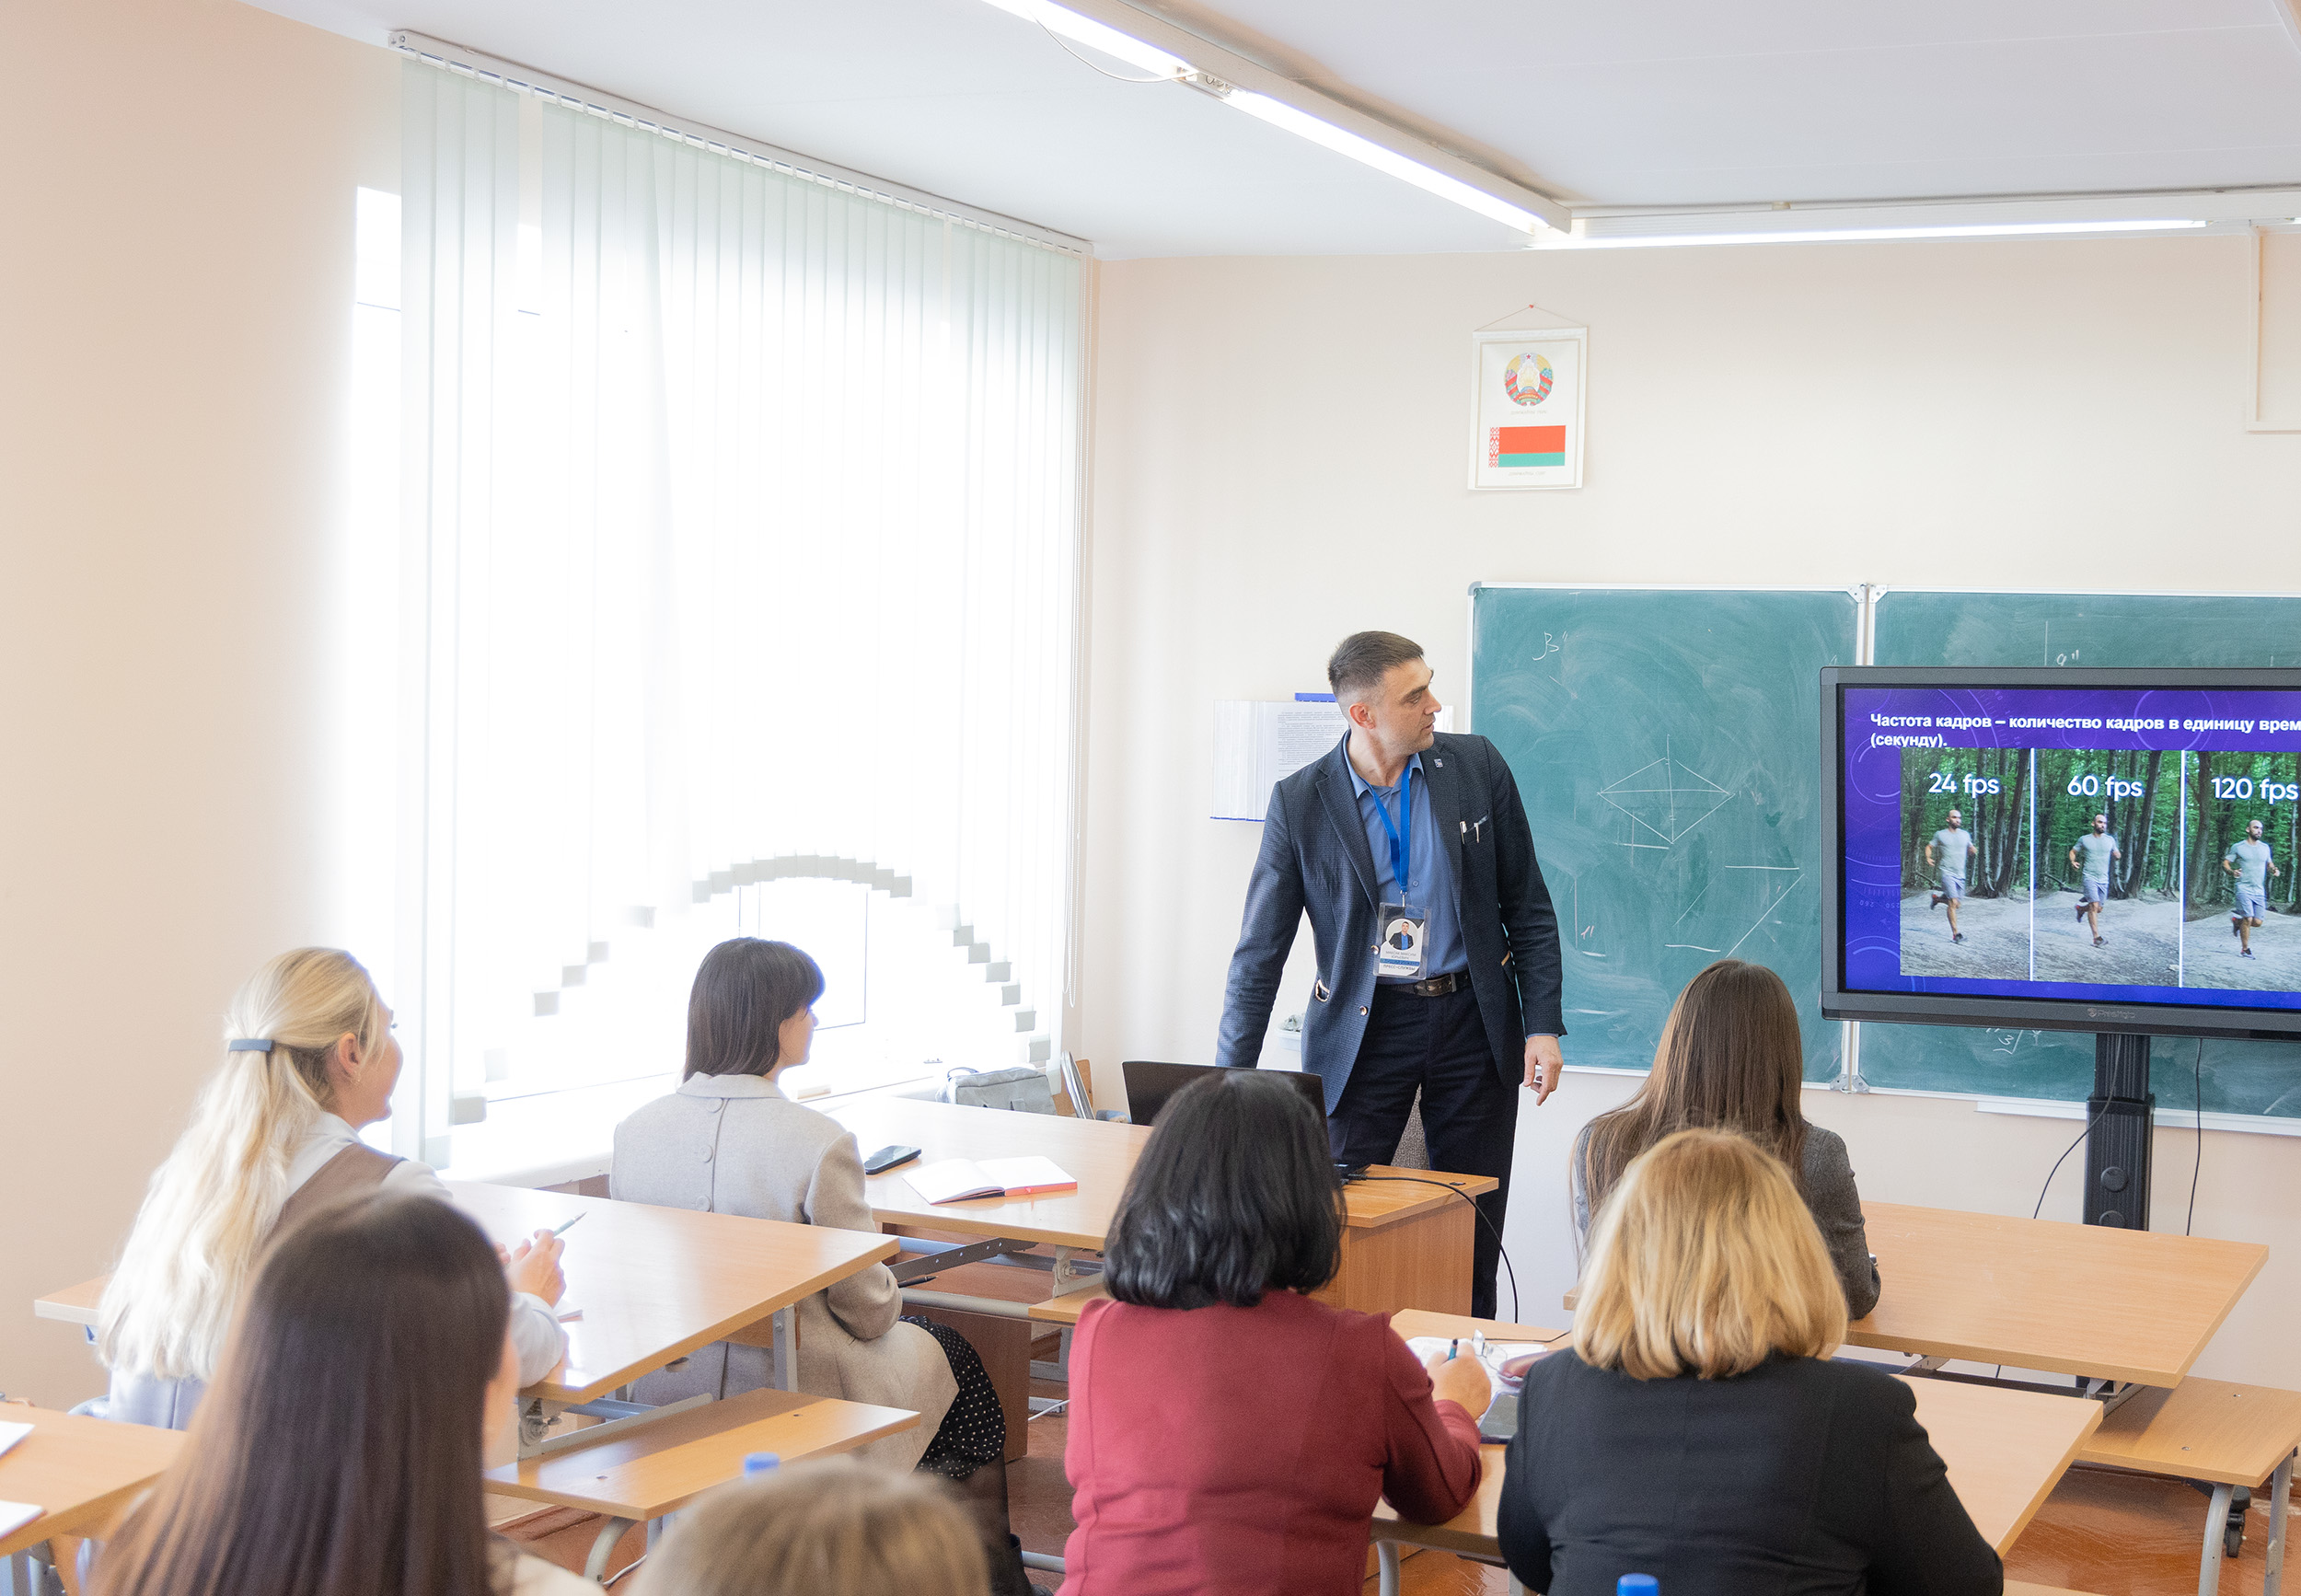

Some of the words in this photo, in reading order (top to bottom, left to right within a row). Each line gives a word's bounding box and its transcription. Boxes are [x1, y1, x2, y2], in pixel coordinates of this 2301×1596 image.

[1870, 713, 1932, 727] Частота
[1936, 716, 1992, 730] кадров
[2009, 717, 2101, 729] количество
[2106, 719, 2164, 733] кадров
[2168, 720, 2180, 730] в
[2182, 719, 2255, 734] единицу
[1870, 733, 1948, 748] (секунду).
[1928, 772, 1957, 793] 24
[1962, 773, 2000, 799] fps
[2067, 775, 2099, 796] 60
[2105, 775, 2143, 802] fps
[2211, 777, 2253, 800] 120
[2259, 778, 2299, 804] fps
